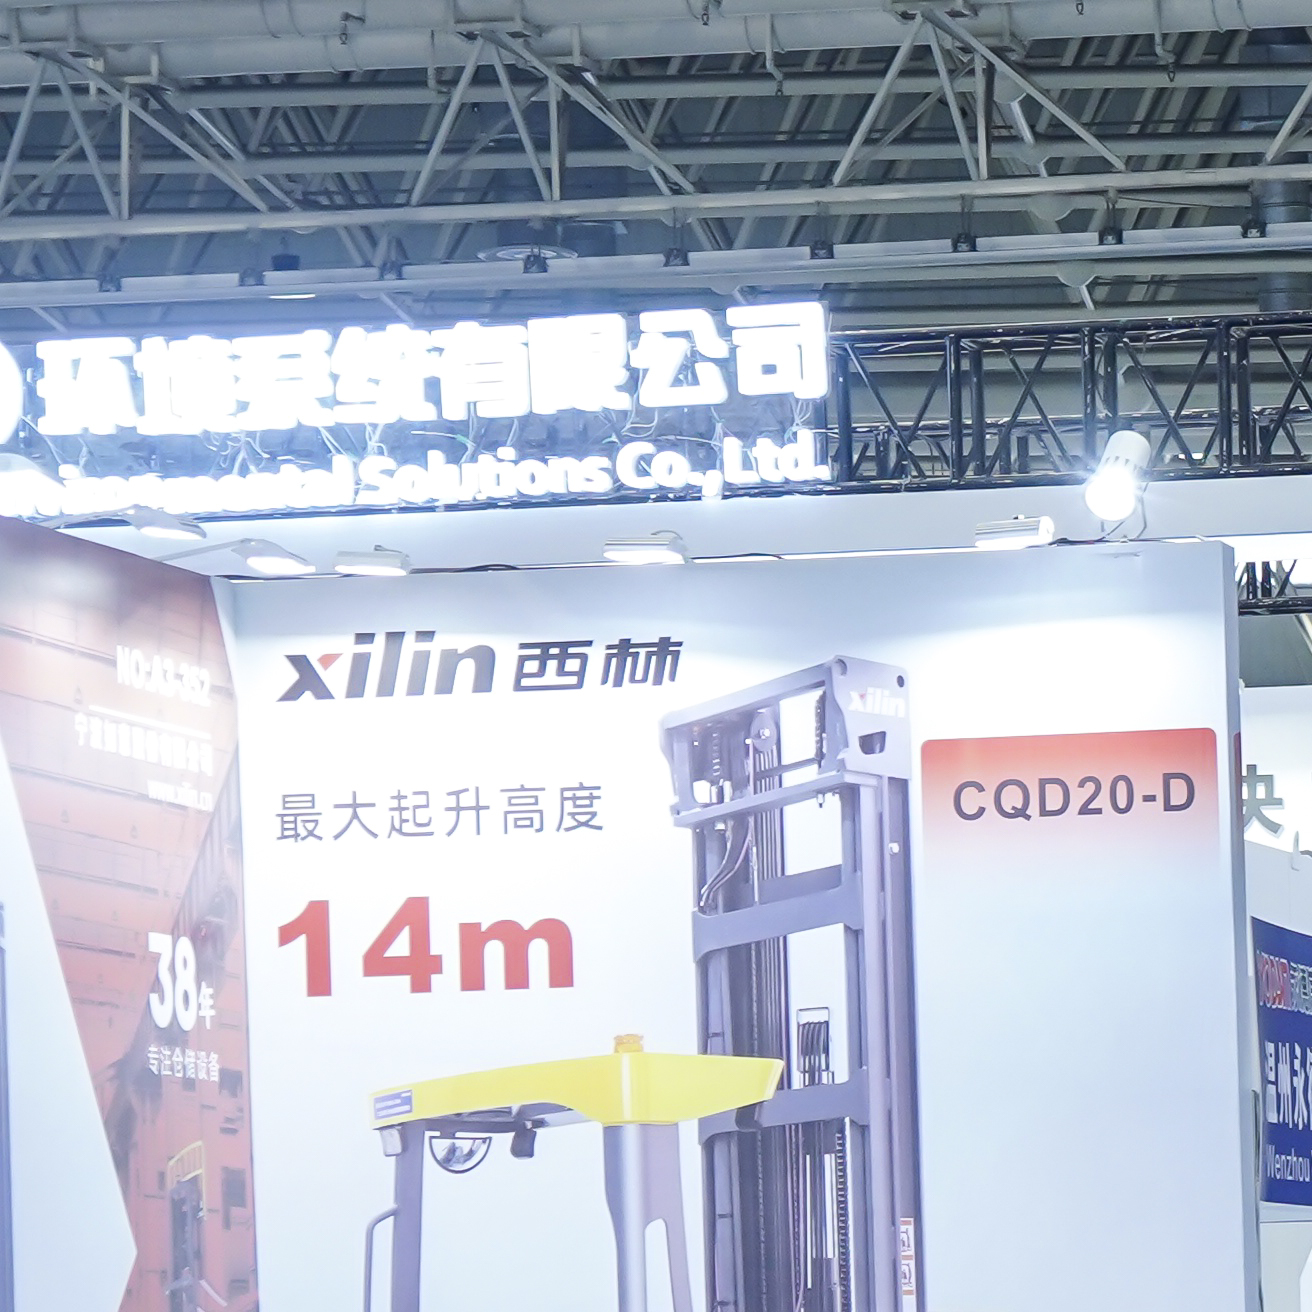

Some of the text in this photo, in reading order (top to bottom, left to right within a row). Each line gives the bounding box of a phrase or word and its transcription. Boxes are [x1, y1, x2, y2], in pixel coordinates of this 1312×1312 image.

[355, 446, 613, 504] Solutions
[723, 429, 831, 484] Ltd.
[278, 630, 684, 702] xilin 西林
[848, 687, 905, 717] xilin
[275, 782, 604, 842] 最大起升高度
[952, 772, 1197, 821] CQD20-D
[278, 896, 575, 997] 14m
[148, 932, 216, 1031] 38年
[1266, 1144, 1310, 1182] Wenzhou
